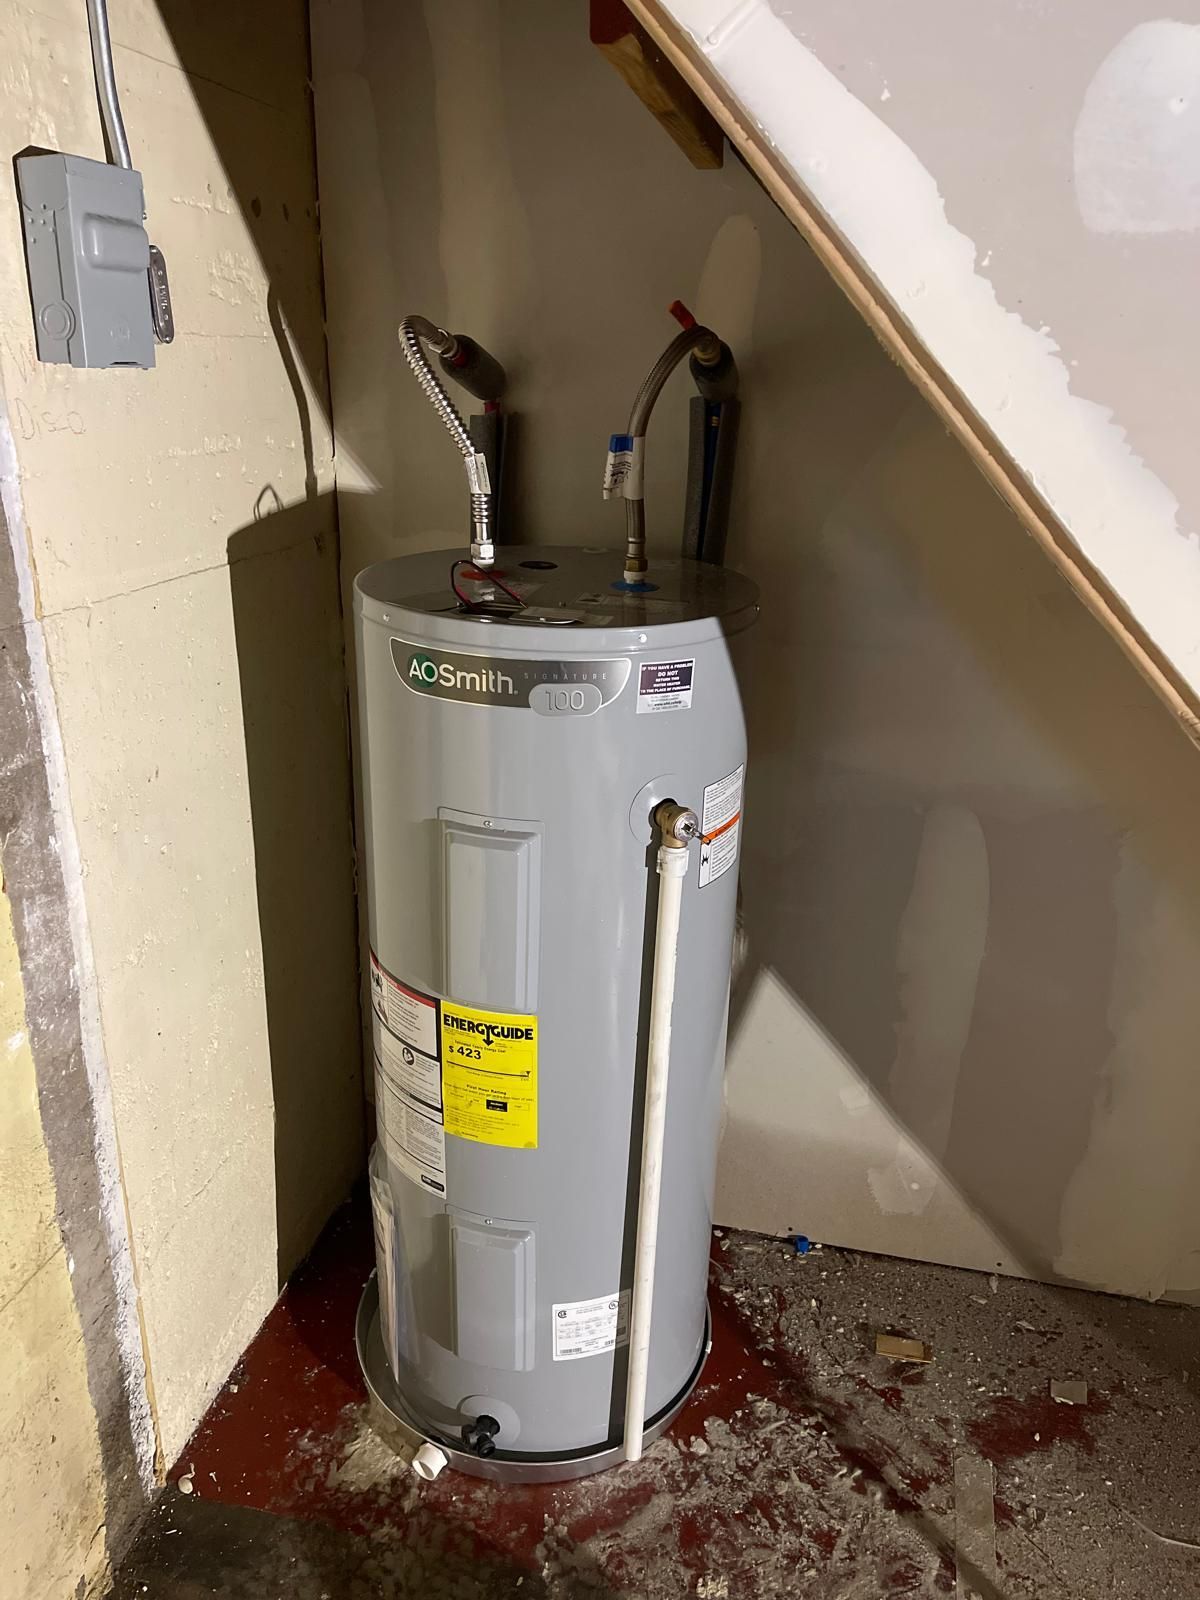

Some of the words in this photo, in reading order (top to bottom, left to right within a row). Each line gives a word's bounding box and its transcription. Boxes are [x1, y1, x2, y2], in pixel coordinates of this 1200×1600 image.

[524, 672, 608, 681] SIGNATURE
[545, 690, 585, 711] 100
[443, 1013, 534, 1046] ENERGYGUIDE
[448, 1045, 454, 1053] $
[457, 1046, 482, 1060] 423
